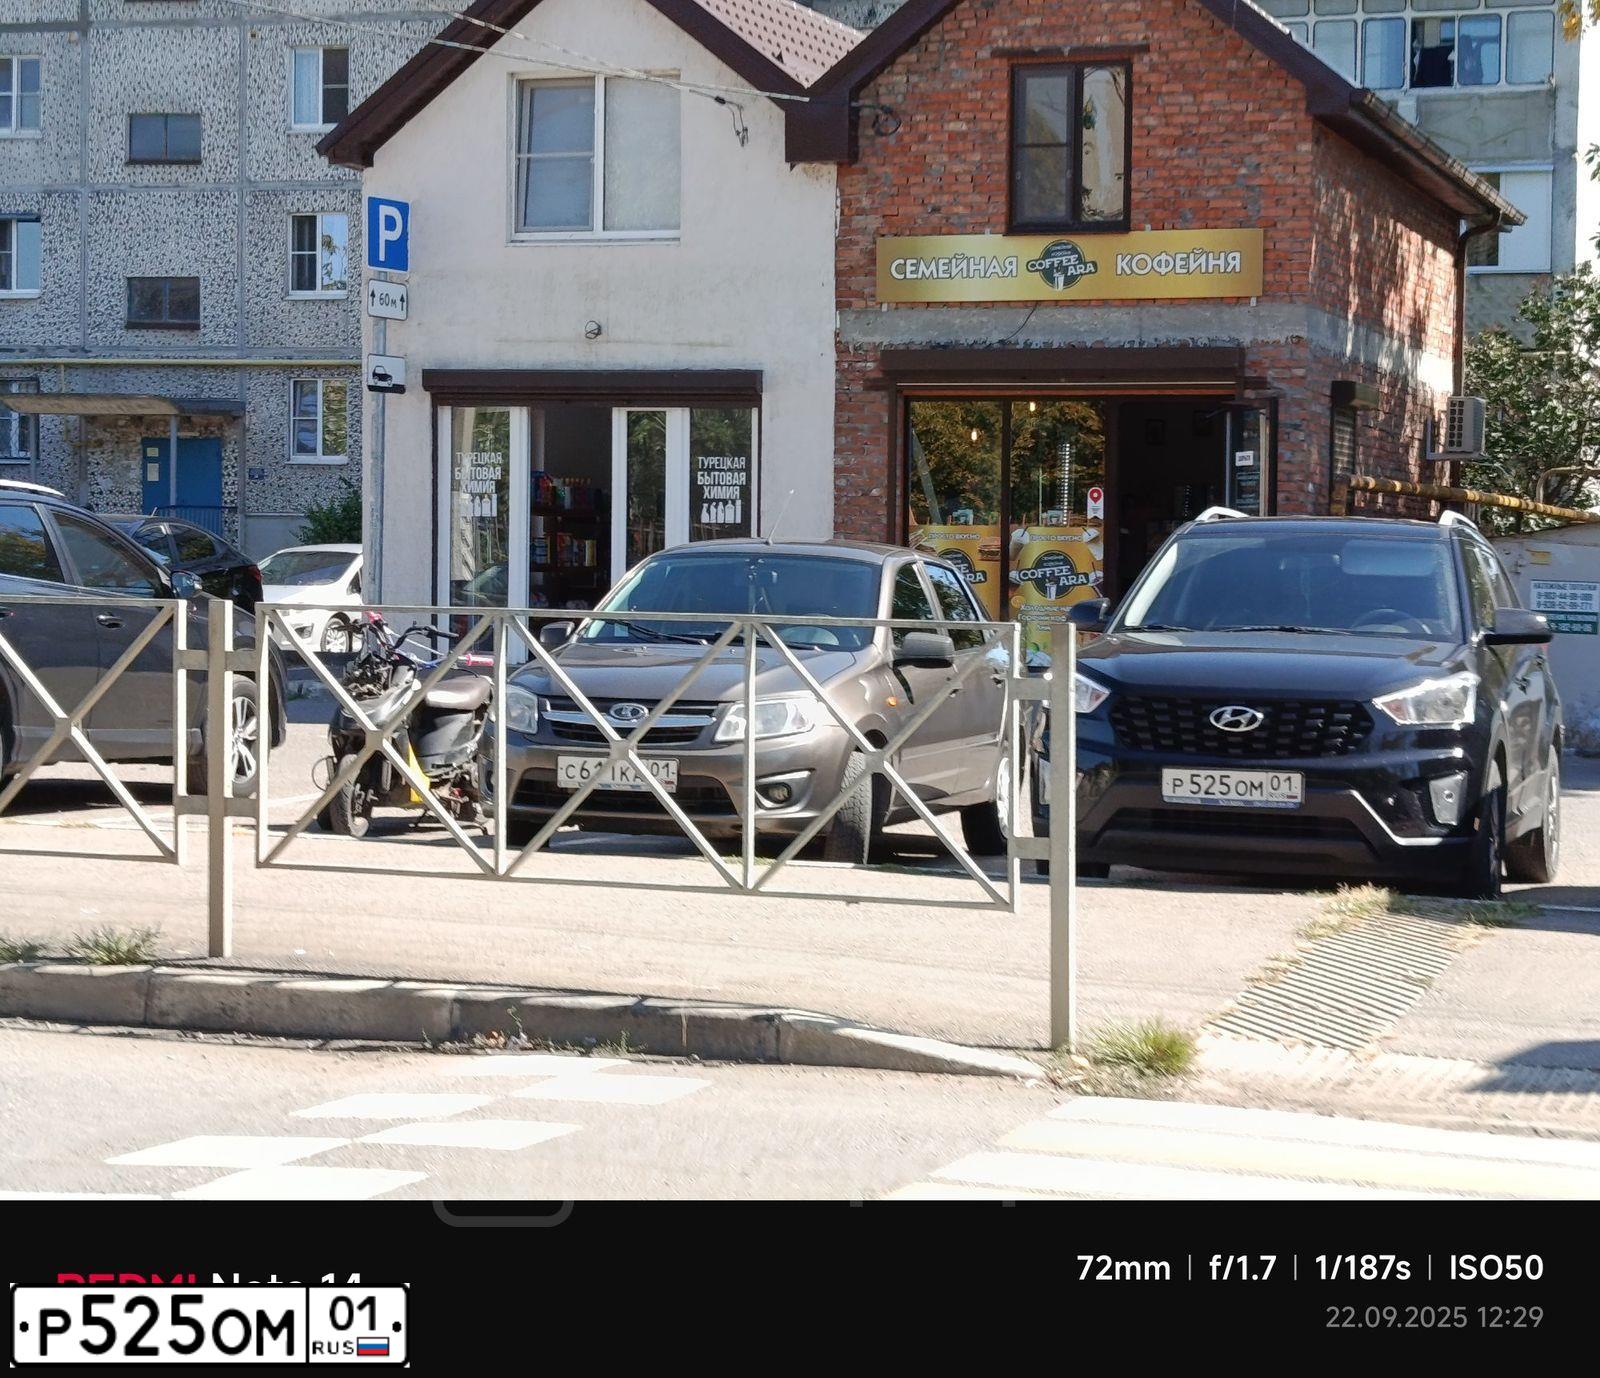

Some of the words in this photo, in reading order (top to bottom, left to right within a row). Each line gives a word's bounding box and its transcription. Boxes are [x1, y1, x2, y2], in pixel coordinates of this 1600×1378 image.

[378, 204, 403, 262] P
[890, 251, 1018, 280] СЕМЕЙНАЯ
[1115, 247, 1242, 275] КОФЕЙНЯ
[1027, 254, 1079, 271] COFFEE
[1067, 262, 1096, 276] ARA
[379, 292, 397, 309] 60м
[698, 456, 746, 470] ТУРЕЦКАЯ
[697, 471, 746, 485] БЫТОВАЯ
[703, 485, 740, 499] ХИМИЯ
[1020, 565, 1071, 580] COFFEE
[1059, 574, 1087, 586] ARA
[651, 762, 669, 777] 01
[1172, 773, 1264, 797] Р525ОМ
[1270, 775, 1292, 791] 01
